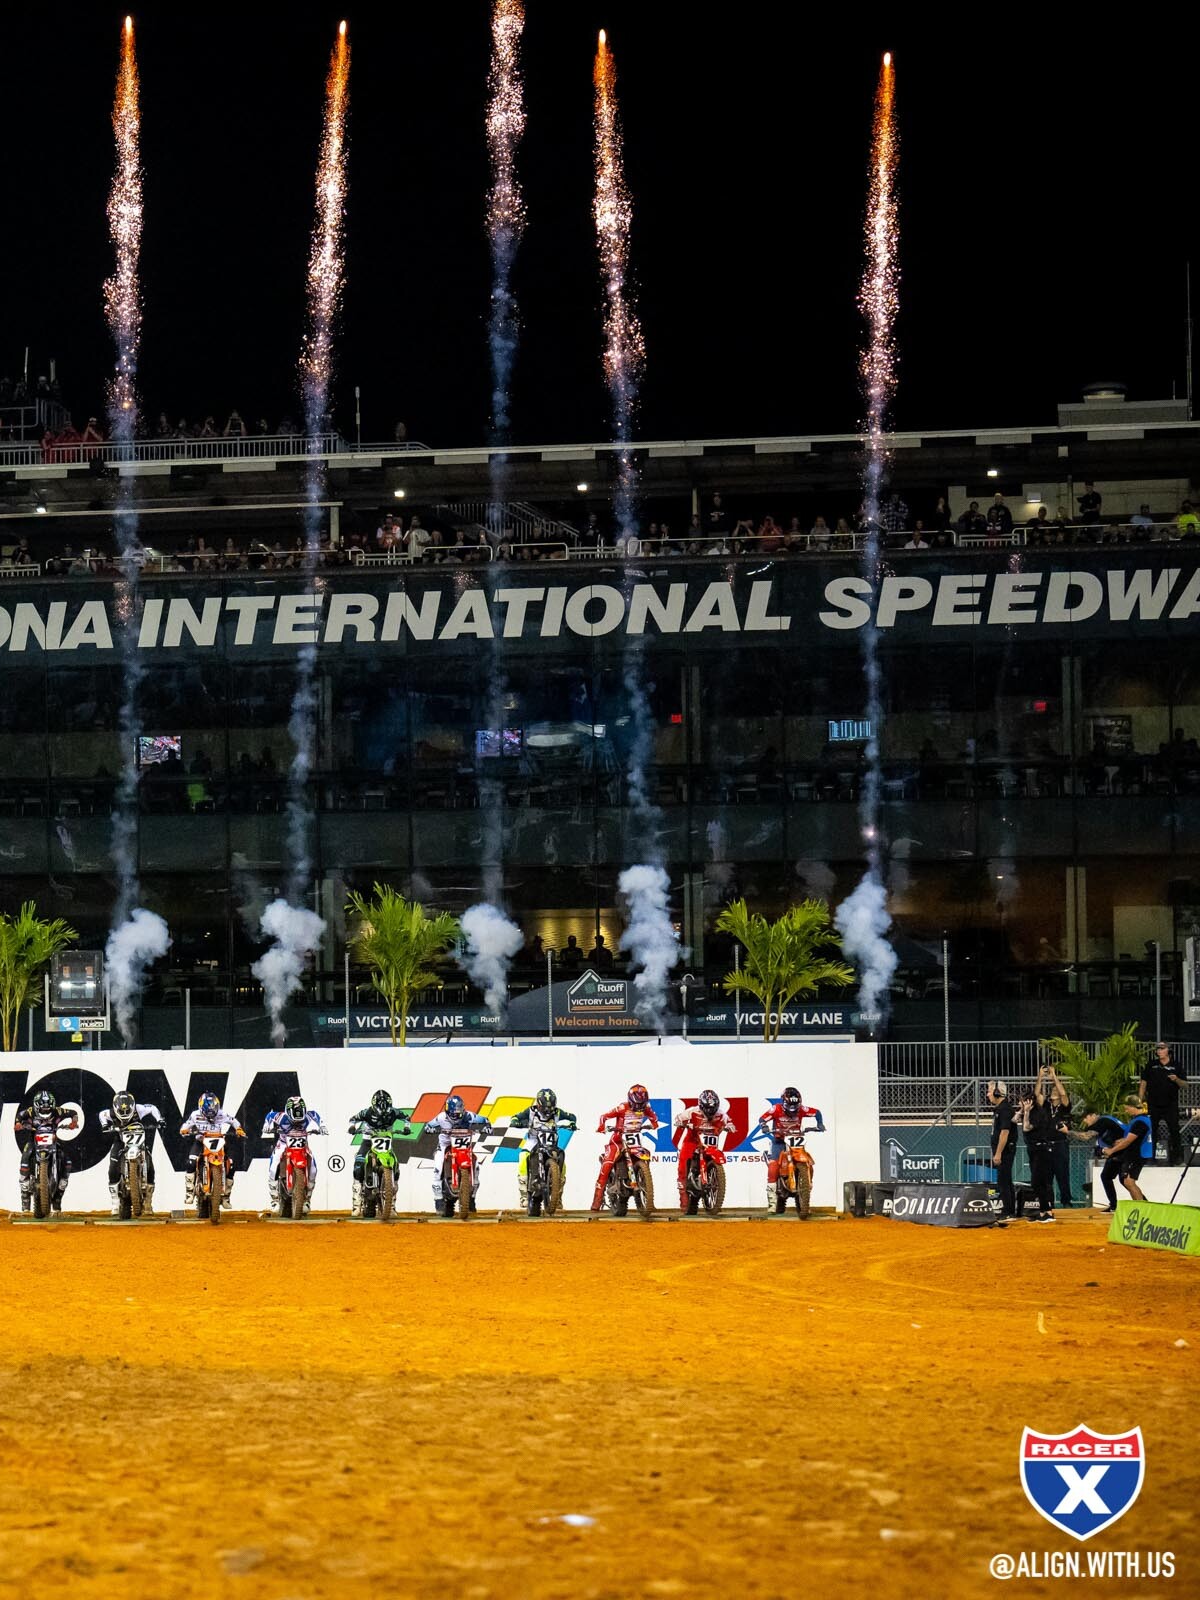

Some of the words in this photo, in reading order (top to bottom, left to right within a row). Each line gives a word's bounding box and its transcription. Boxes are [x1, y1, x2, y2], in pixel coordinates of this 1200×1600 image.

[137, 580, 791, 648] INTERNATIONAL
[597, 983, 624, 992] Ruoff
[571, 998, 602, 1006] VICTORY
[356, 1015, 419, 1028] VICTORY
[424, 1015, 464, 1028] LANE
[555, 1016, 605, 1027] Welcome
[734, 1012, 798, 1025] VICTORY
[803, 1012, 843, 1025] LANE
[125, 1134, 143, 1145] 27
[289, 1138, 306, 1148] 23
[454, 1138, 471, 1148] 94
[540, 1131, 556, 1145] 14
[625, 1133, 641, 1146] 51
[702, 1135, 717, 1146] 10
[788, 1136, 805, 1147] 12
[208, 1139, 220, 1150] 1
[373, 1138, 390, 1150] 21
[902, 1158, 940, 1170] Ruoff
[908, 1197, 961, 1215] OAKLEY
[1136, 1216, 1191, 1250] Kawasaki
